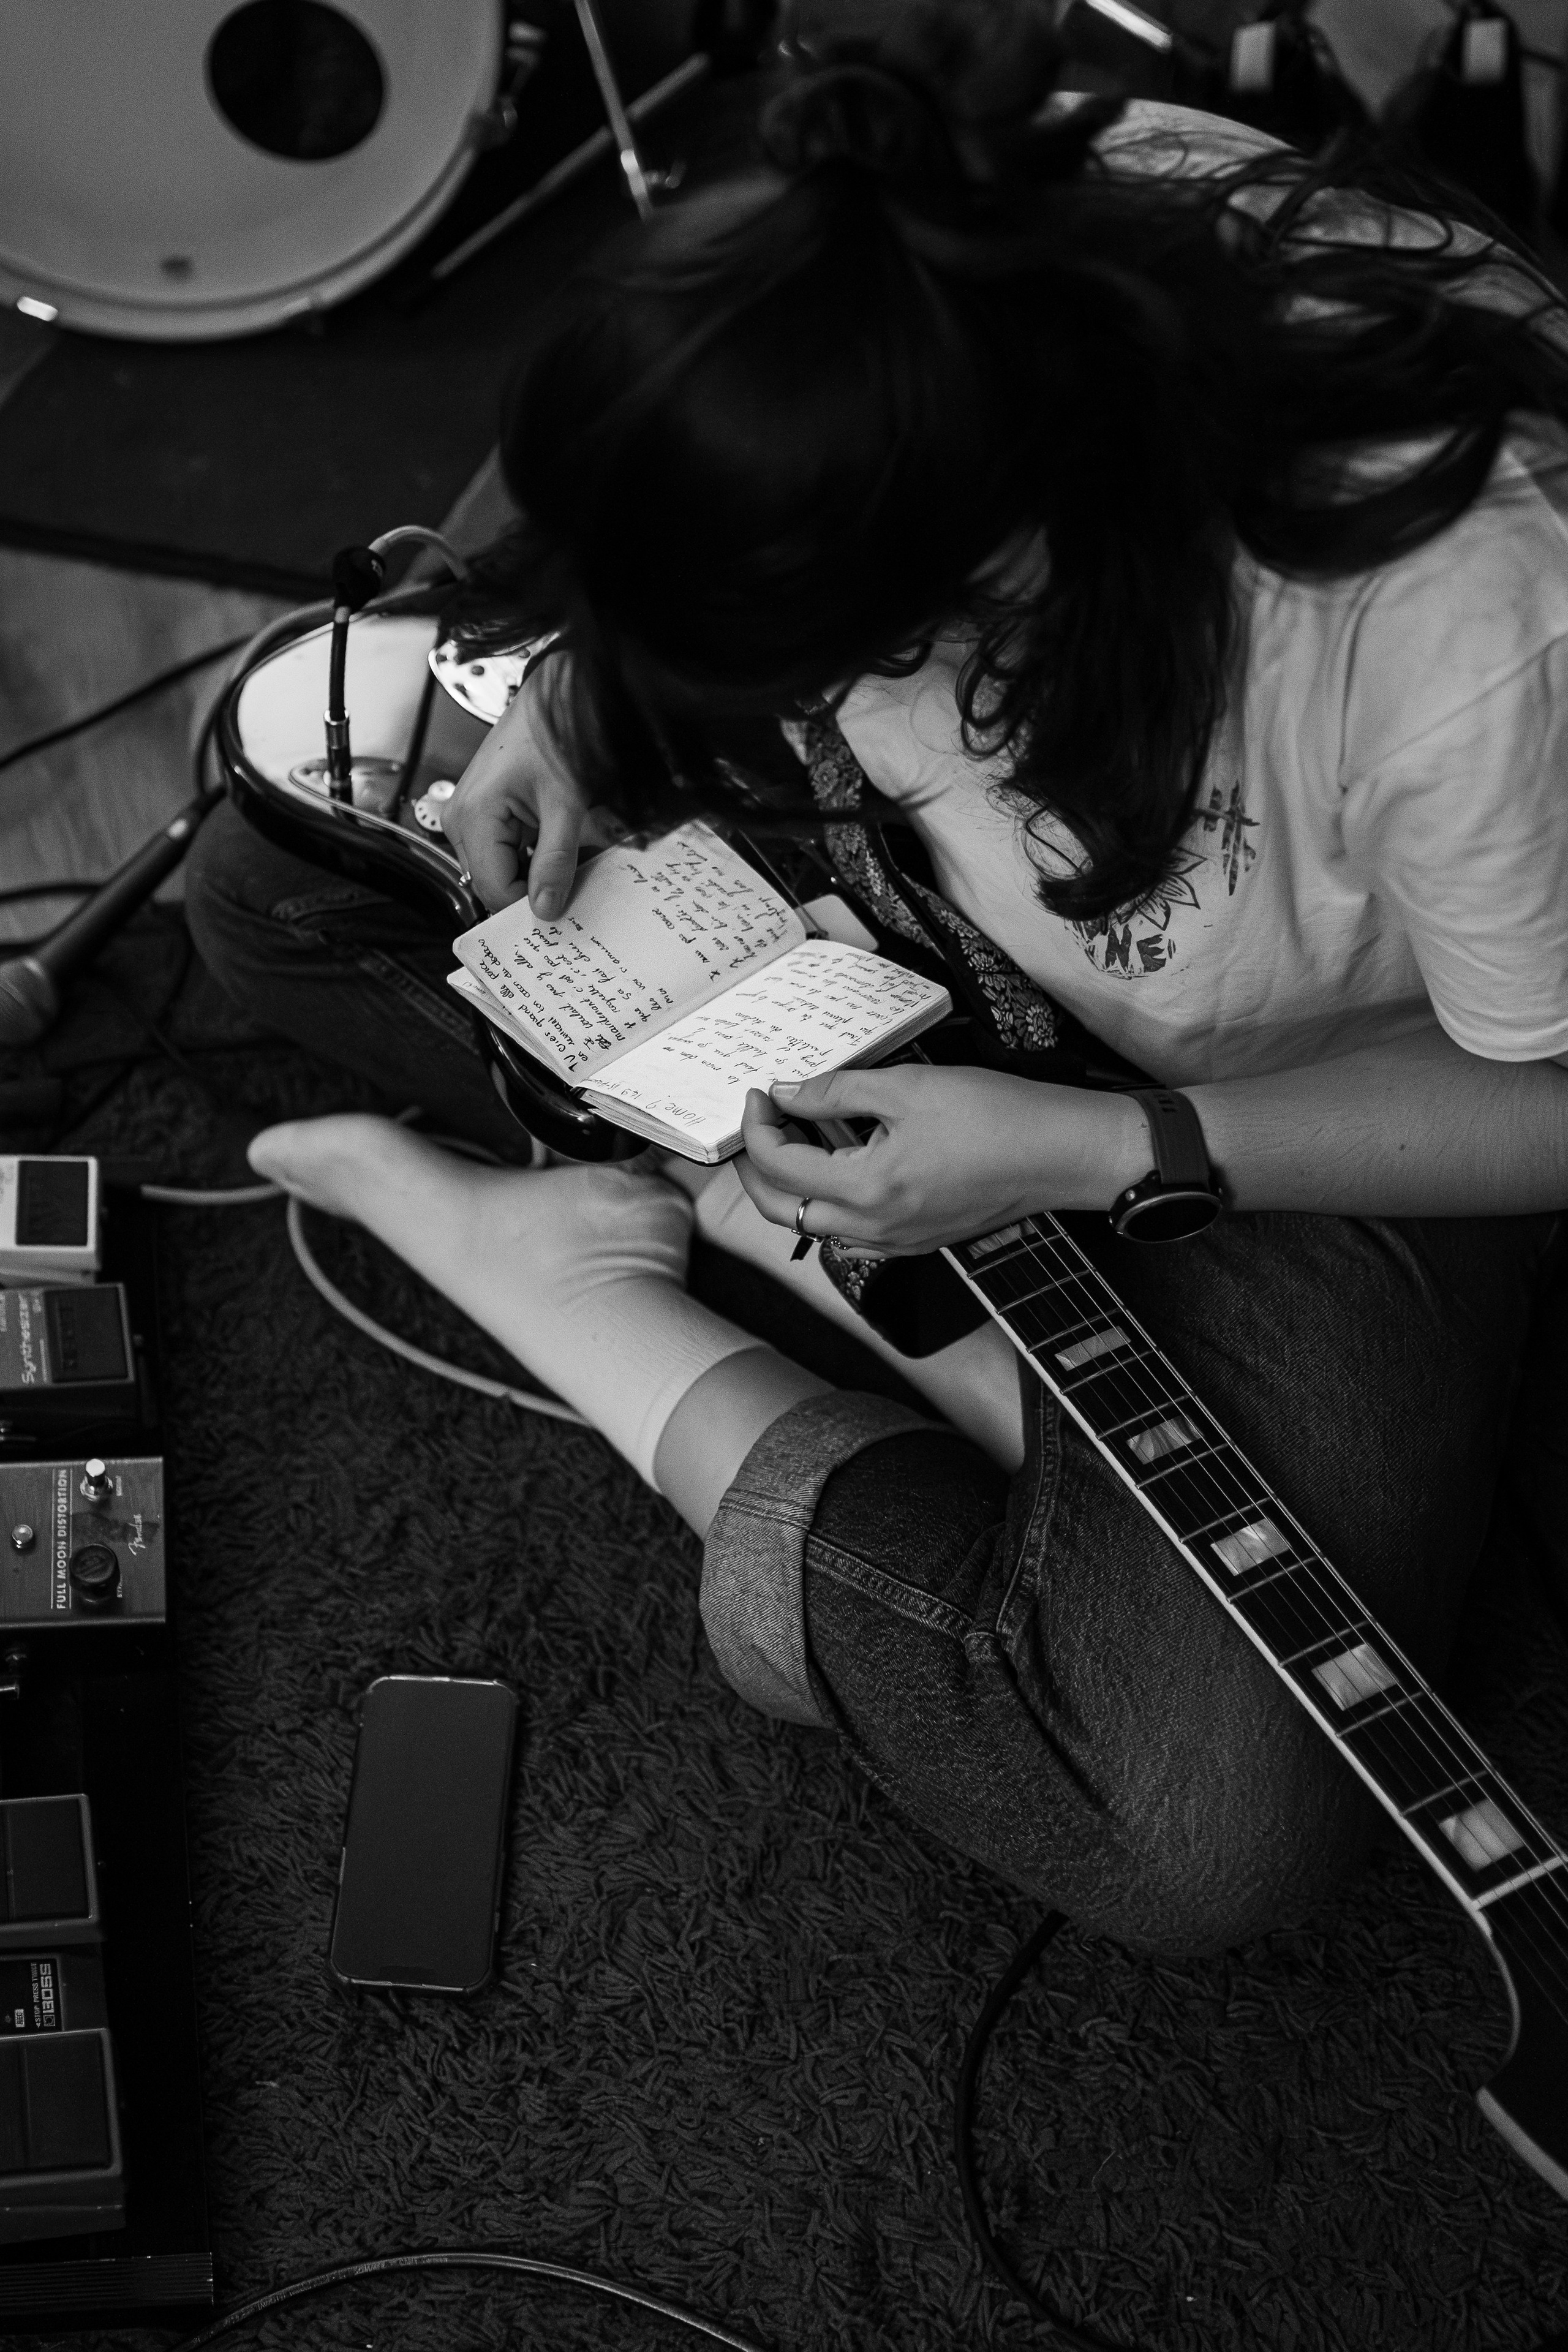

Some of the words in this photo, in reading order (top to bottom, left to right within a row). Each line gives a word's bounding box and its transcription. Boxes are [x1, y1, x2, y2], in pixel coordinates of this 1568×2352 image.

[517, 1003, 546, 1028] quand
[578, 997, 626, 1042] maintenant
[57, 1468, 69, 1537] DISTORTION
[56, 1540, 67, 1578] MOON
[56, 1580, 68, 1609] FULL
[40, 1964, 53, 2013] BOSS
